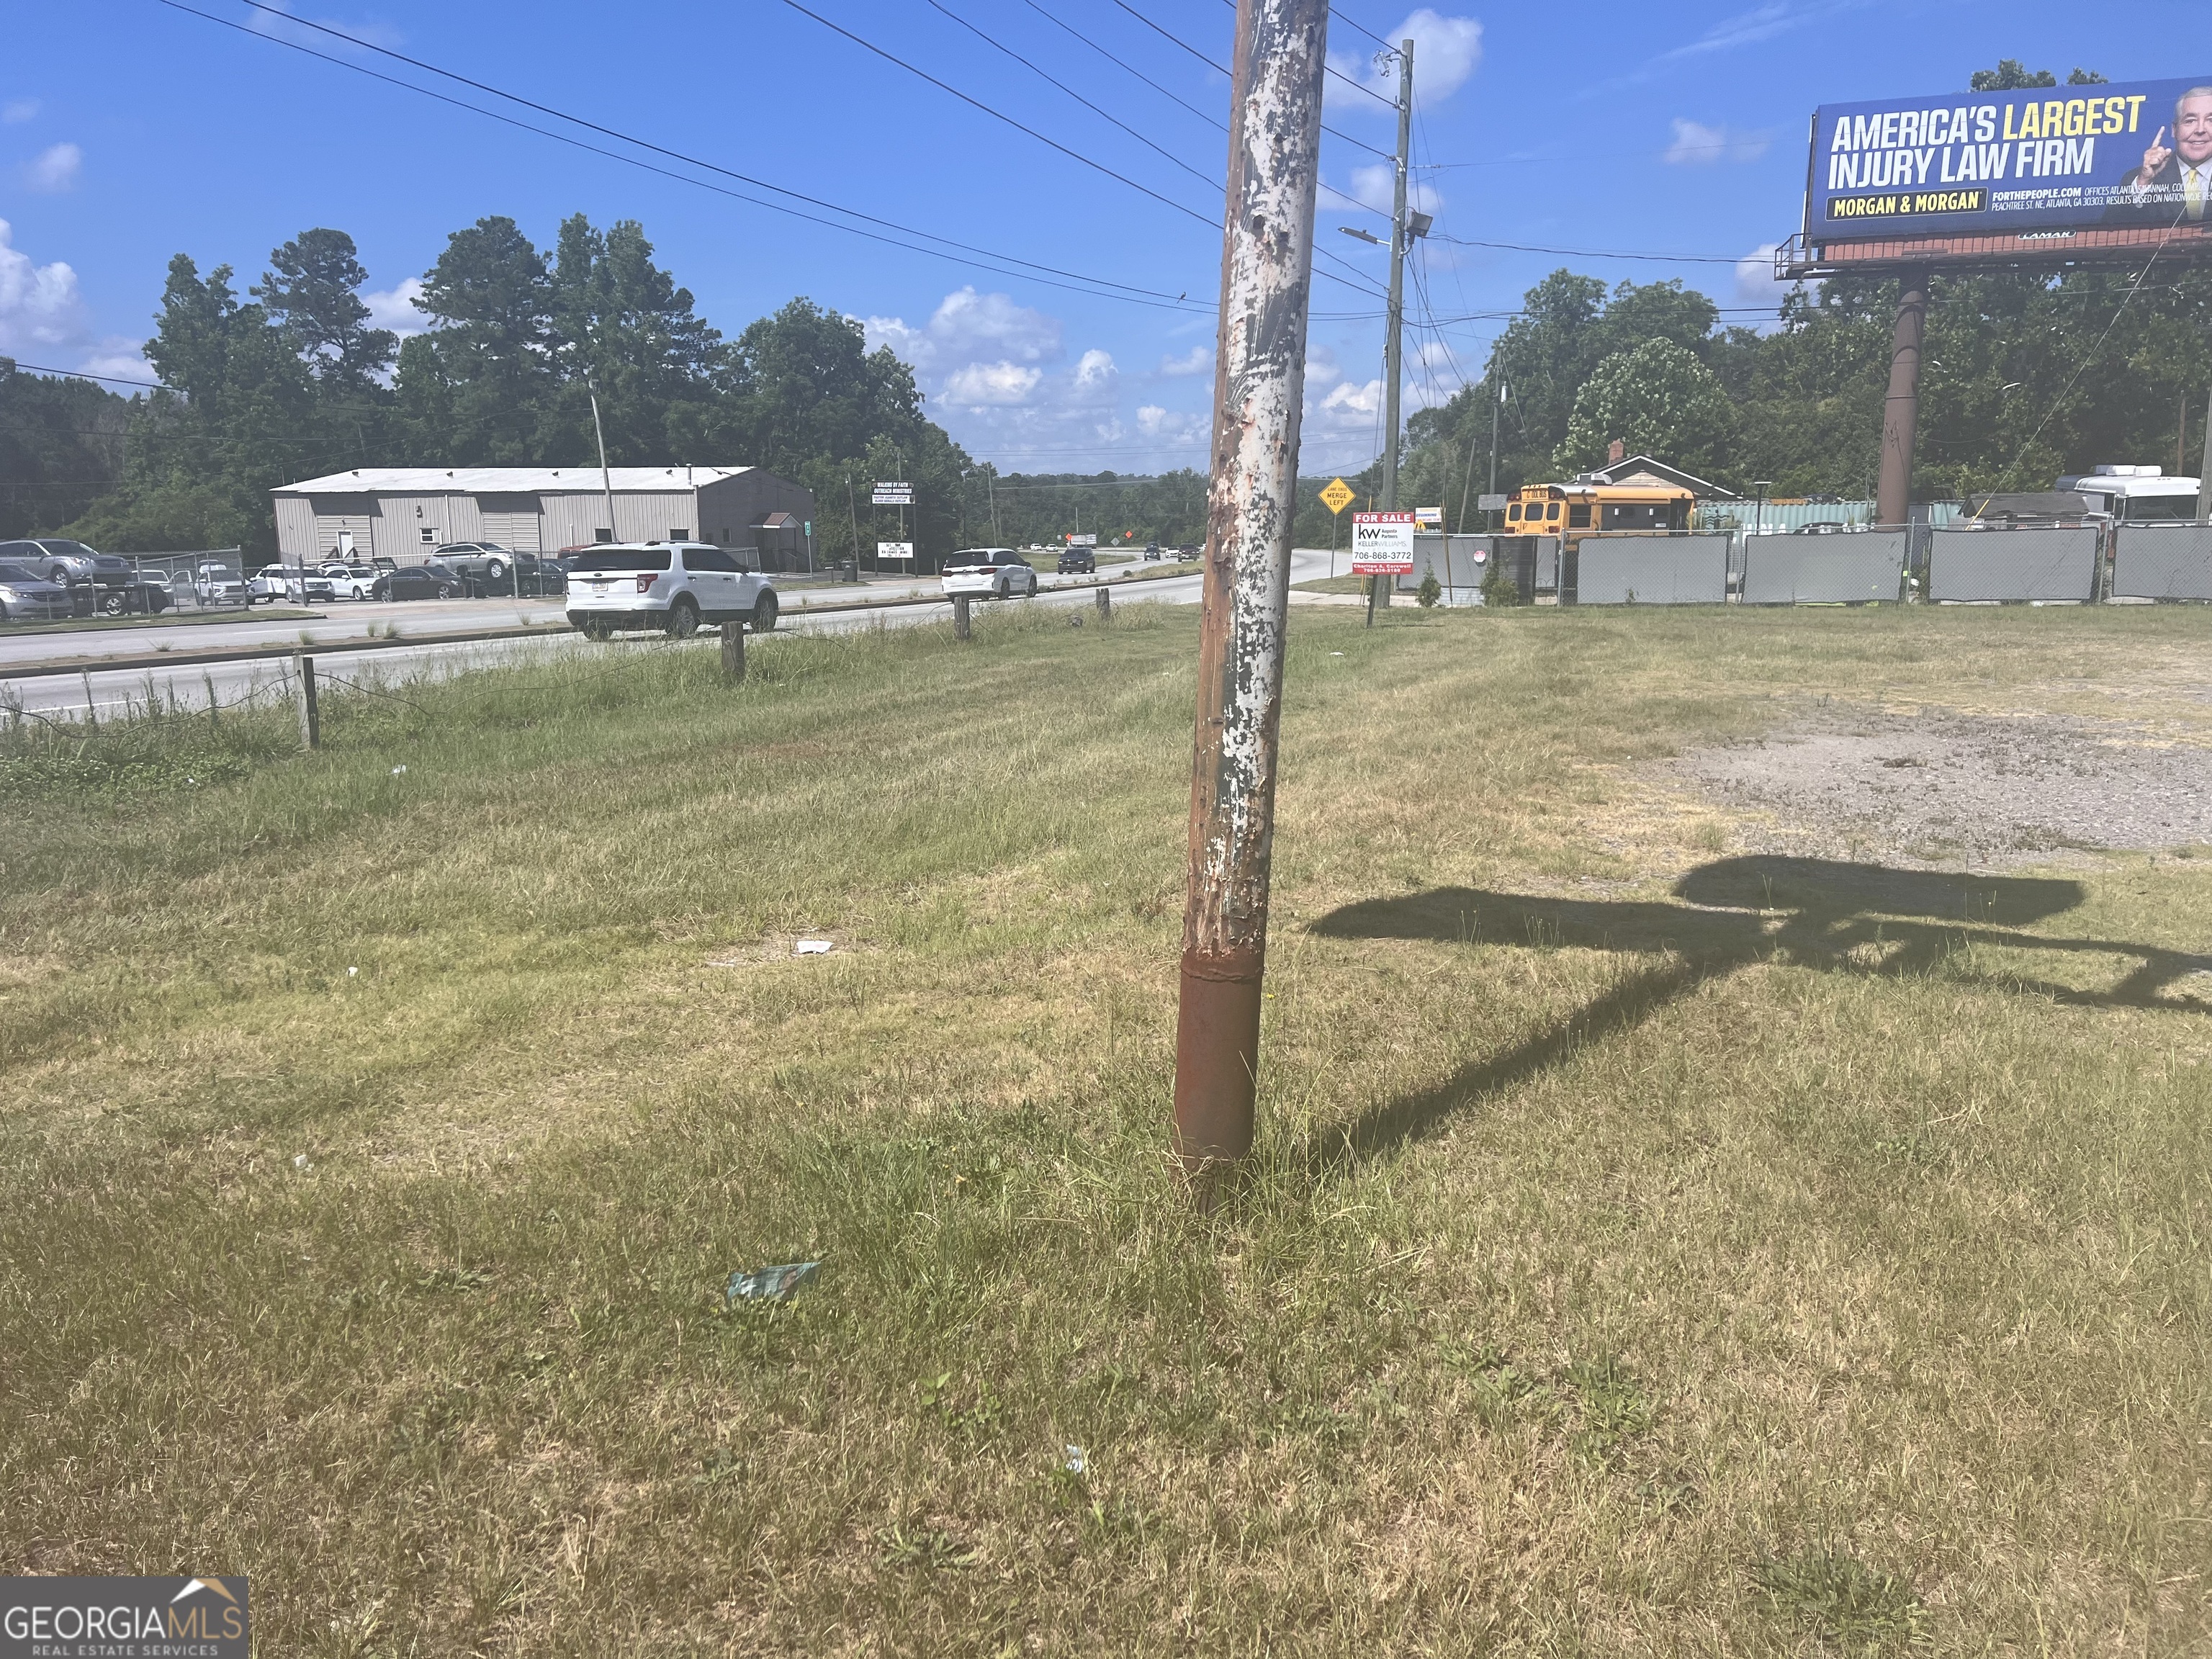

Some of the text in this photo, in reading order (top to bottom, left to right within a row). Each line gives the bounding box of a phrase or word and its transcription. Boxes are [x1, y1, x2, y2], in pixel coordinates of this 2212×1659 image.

[1831, 95, 2146, 152] AMERICA'S LARGEST
[1828, 137, 2095, 189] INJURY LAW FIRM
[1834, 191, 1979, 217] MORGAN & MORGAN
[1992, 187, 2082, 202] FORTHEPEOPLE.COM
[2084, 185, 2110, 196] OFFICES
[1992, 202, 2025, 212] PEACHTREE
[2035, 199, 2046, 210] NE,
[2046, 198, 2072, 208] ATLANTA,
[2073, 198, 2082, 207] GA
[2106, 194, 2132, 205] RESULTS
[2132, 193, 2152, 204] BASED
[2153, 193, 2164, 202] ON
[1355, 514, 1411, 523] FOR SALE
